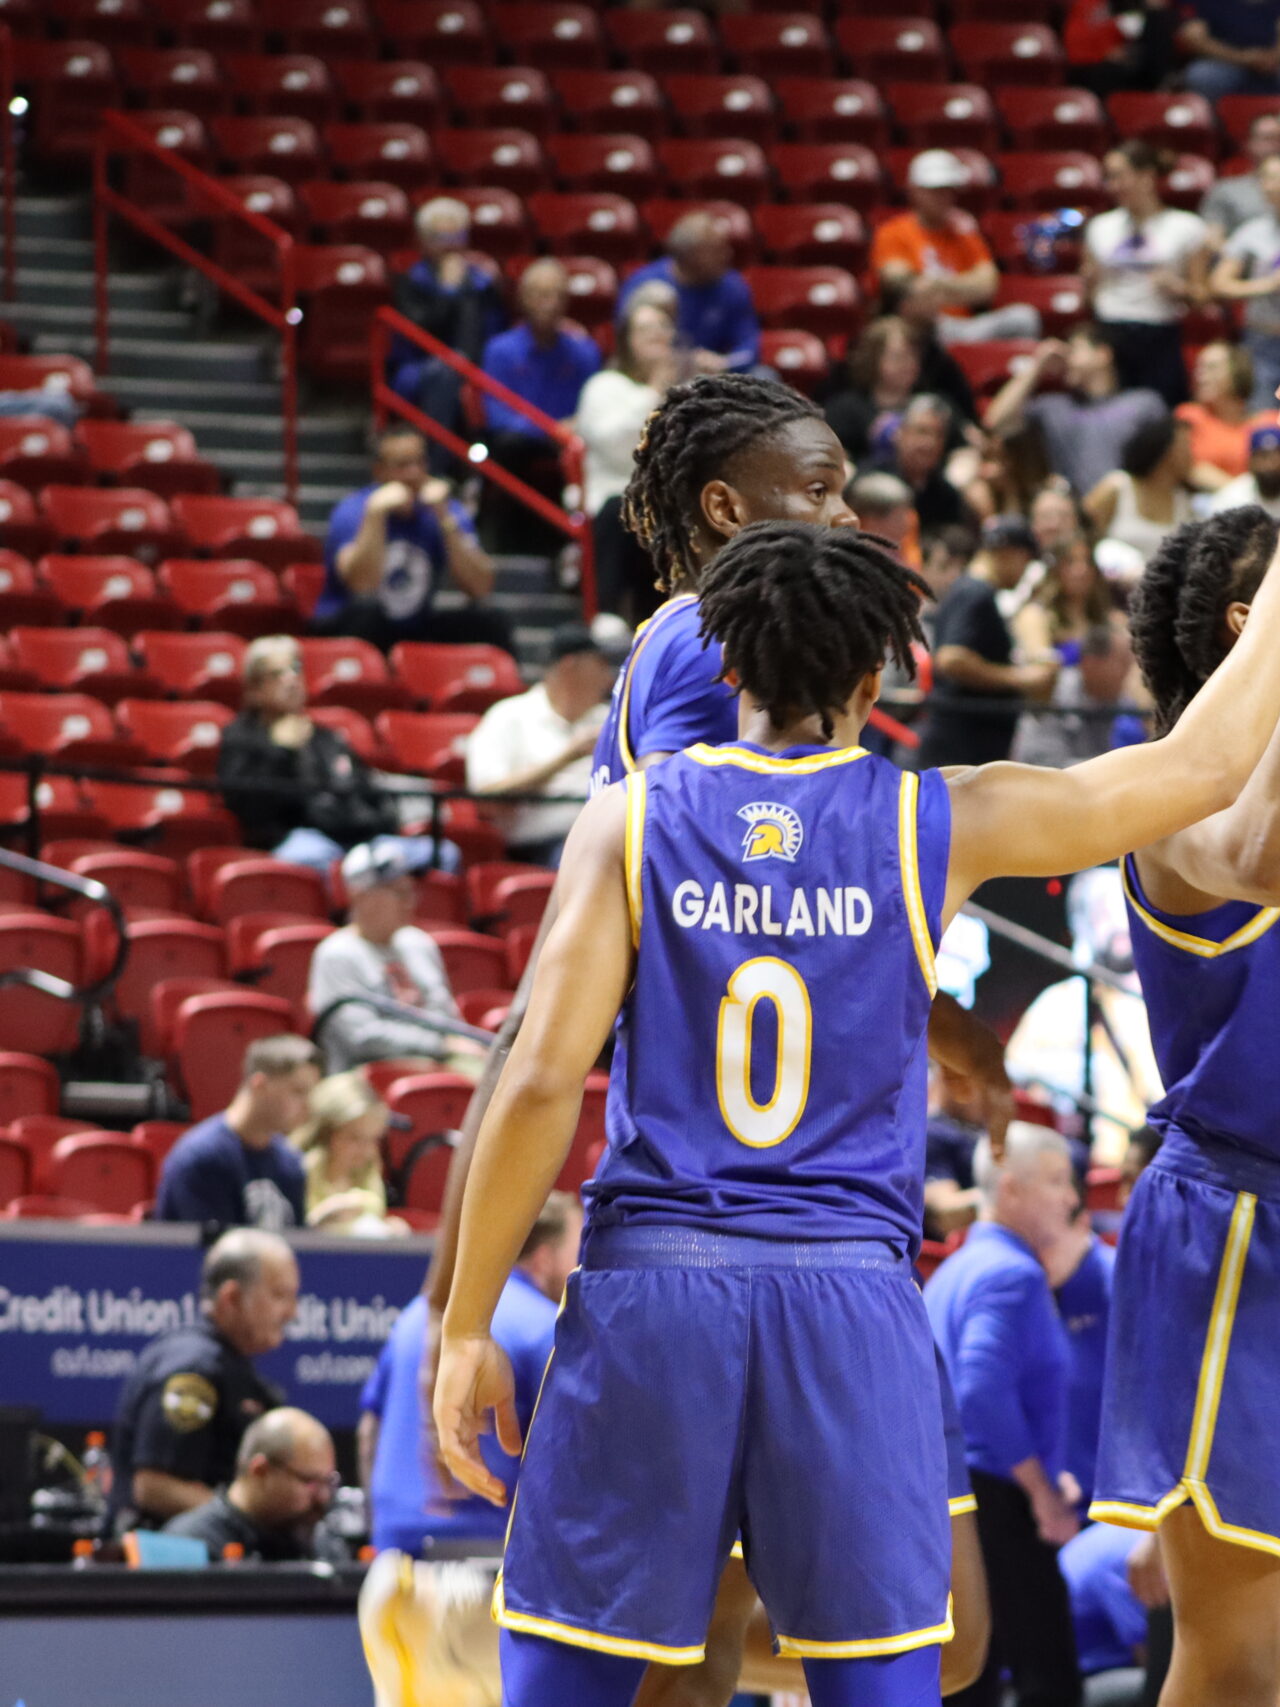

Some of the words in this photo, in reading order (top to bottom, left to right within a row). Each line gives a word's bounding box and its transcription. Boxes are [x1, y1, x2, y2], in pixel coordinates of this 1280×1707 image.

[672, 879, 873, 937] GARLAND
[715, 955, 813, 1149] 0
[87, 1288, 180, 1334] Union
